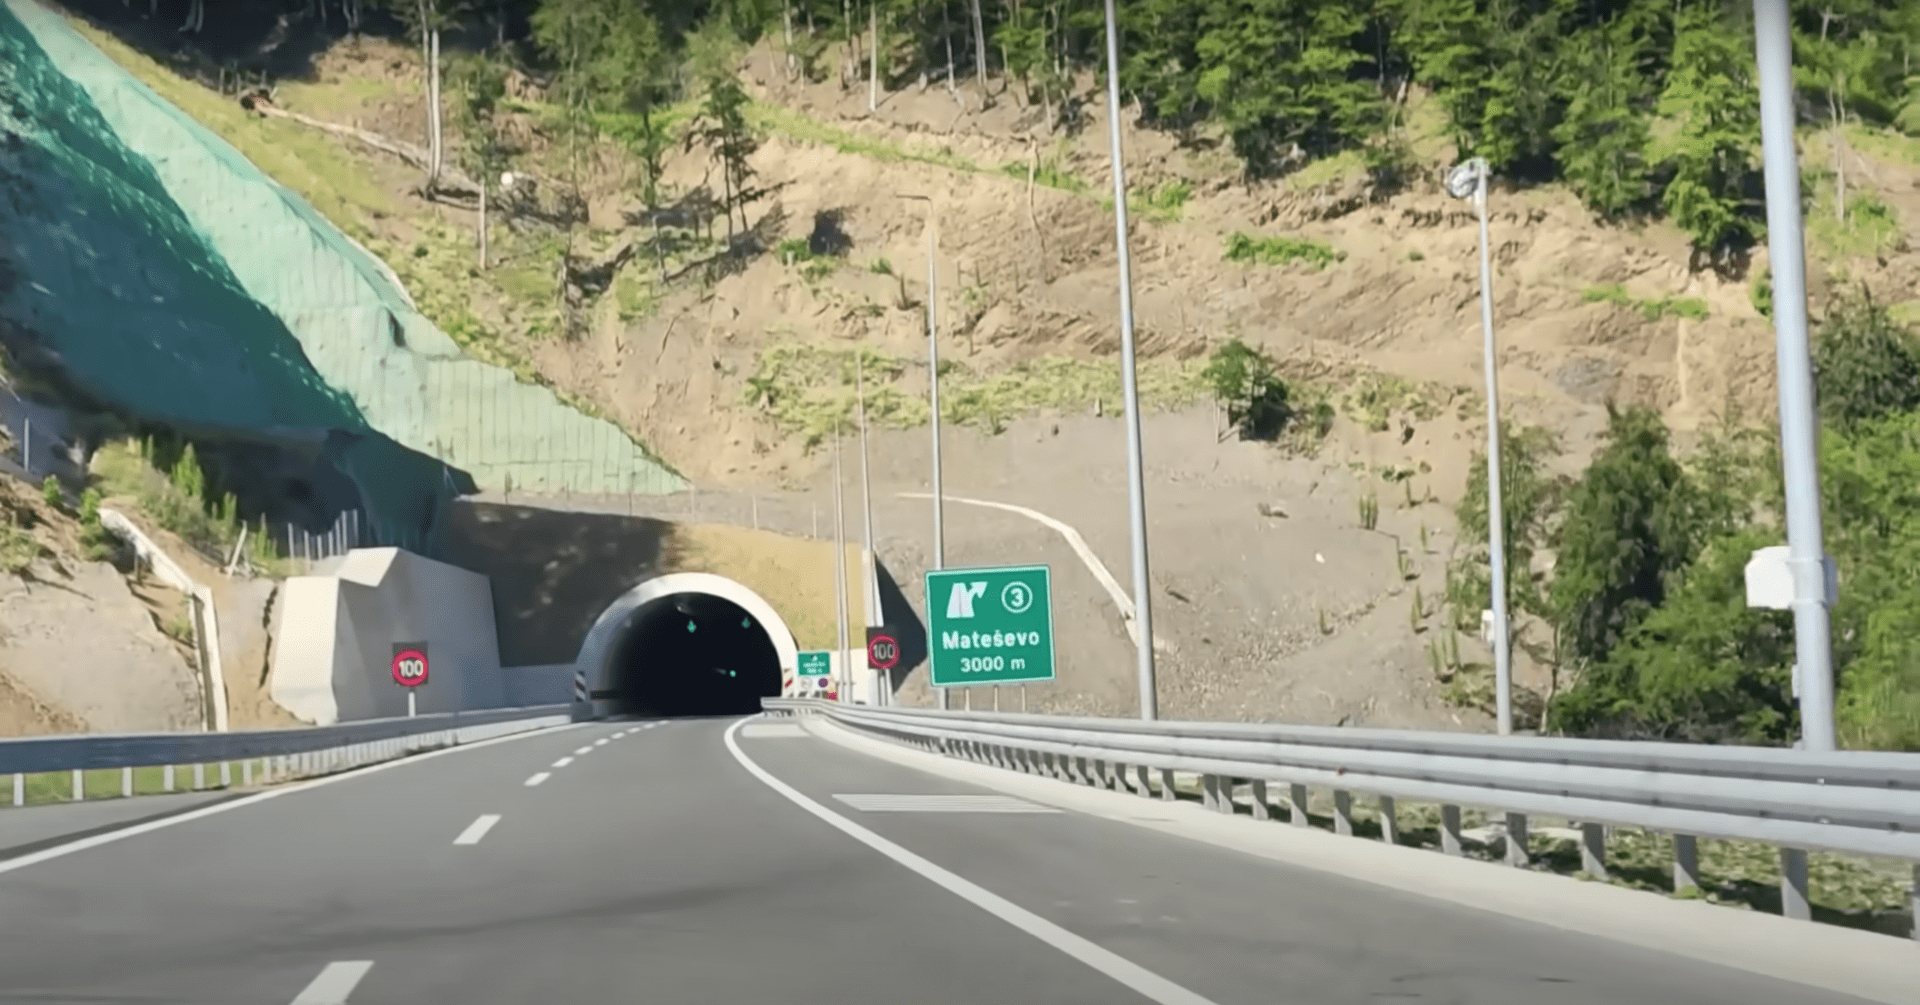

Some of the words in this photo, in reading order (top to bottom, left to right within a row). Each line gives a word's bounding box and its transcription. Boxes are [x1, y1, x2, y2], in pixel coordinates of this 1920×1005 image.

[1010, 587, 1024, 608] 3
[942, 629, 1040, 650] Mateševo
[874, 643, 895, 660] 100
[399, 660, 424, 677] 100
[960, 655, 1004, 673] 3000
[1010, 657, 1026, 671] m
